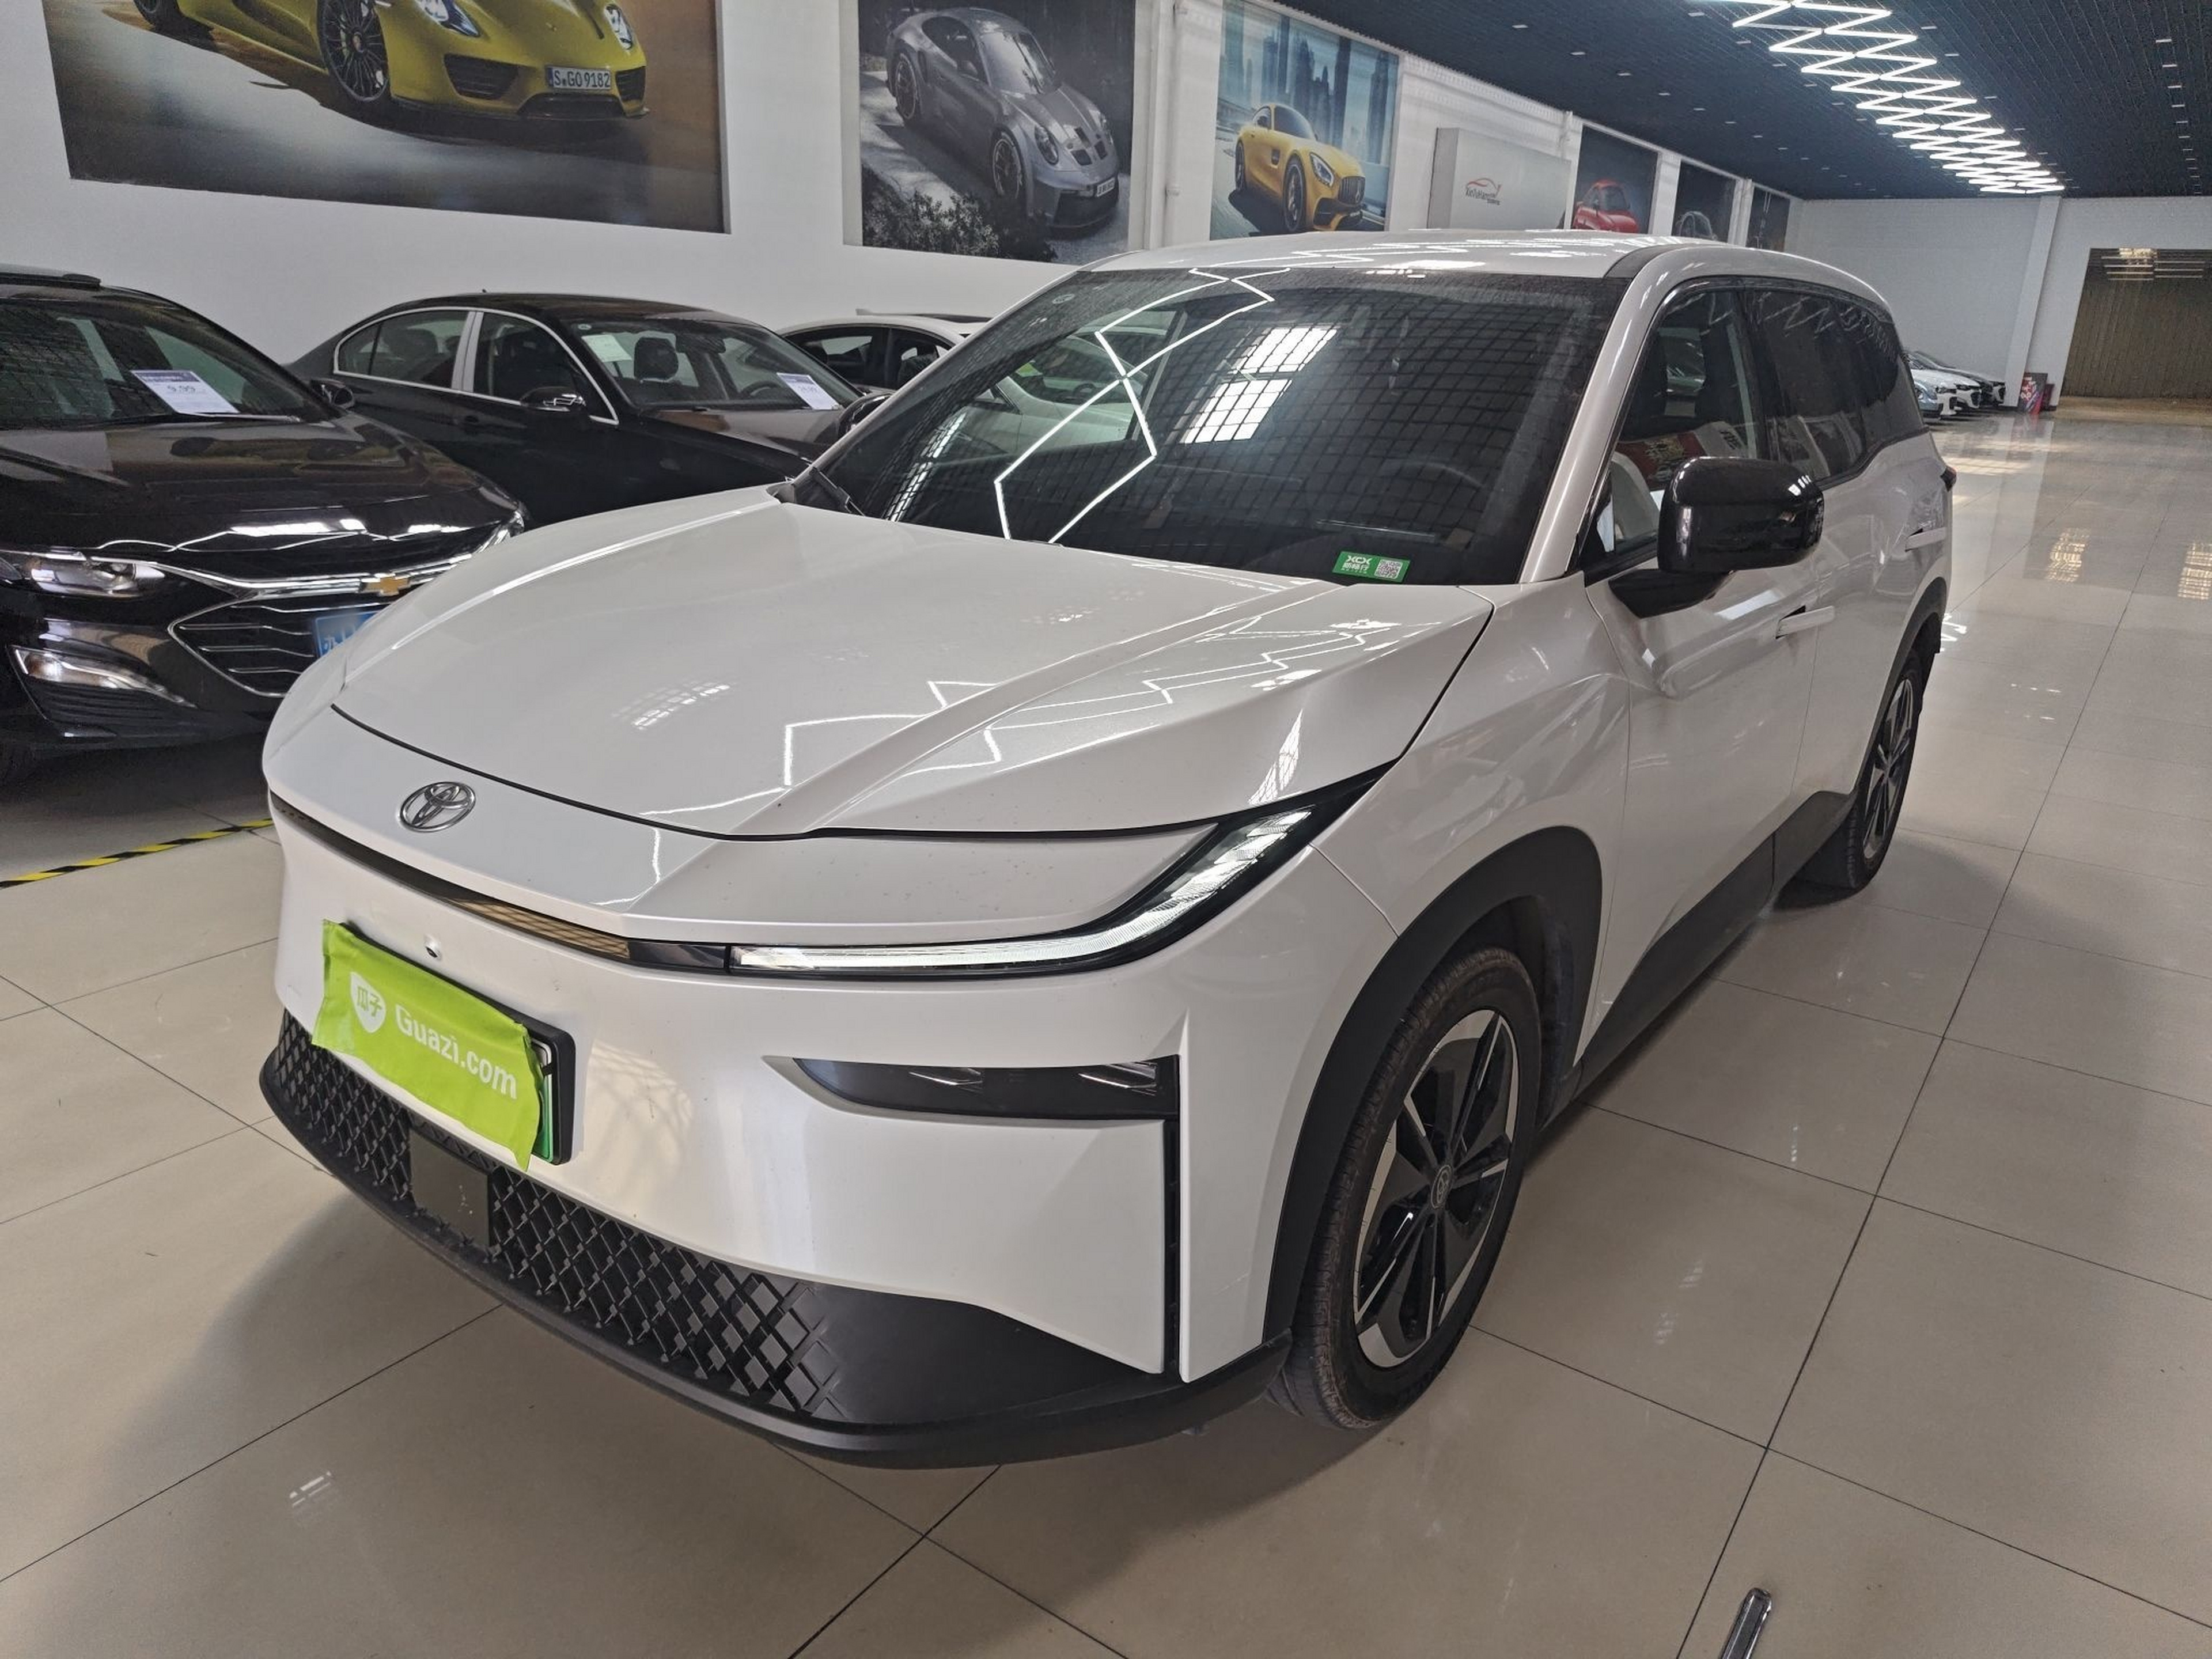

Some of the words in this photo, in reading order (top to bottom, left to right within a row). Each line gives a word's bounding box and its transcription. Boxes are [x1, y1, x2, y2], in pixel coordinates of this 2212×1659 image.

[584, 72, 610, 88] 9182
[356, 986, 382, 1017] 瓜子
[395, 1003, 517, 1100] Guazi.com
